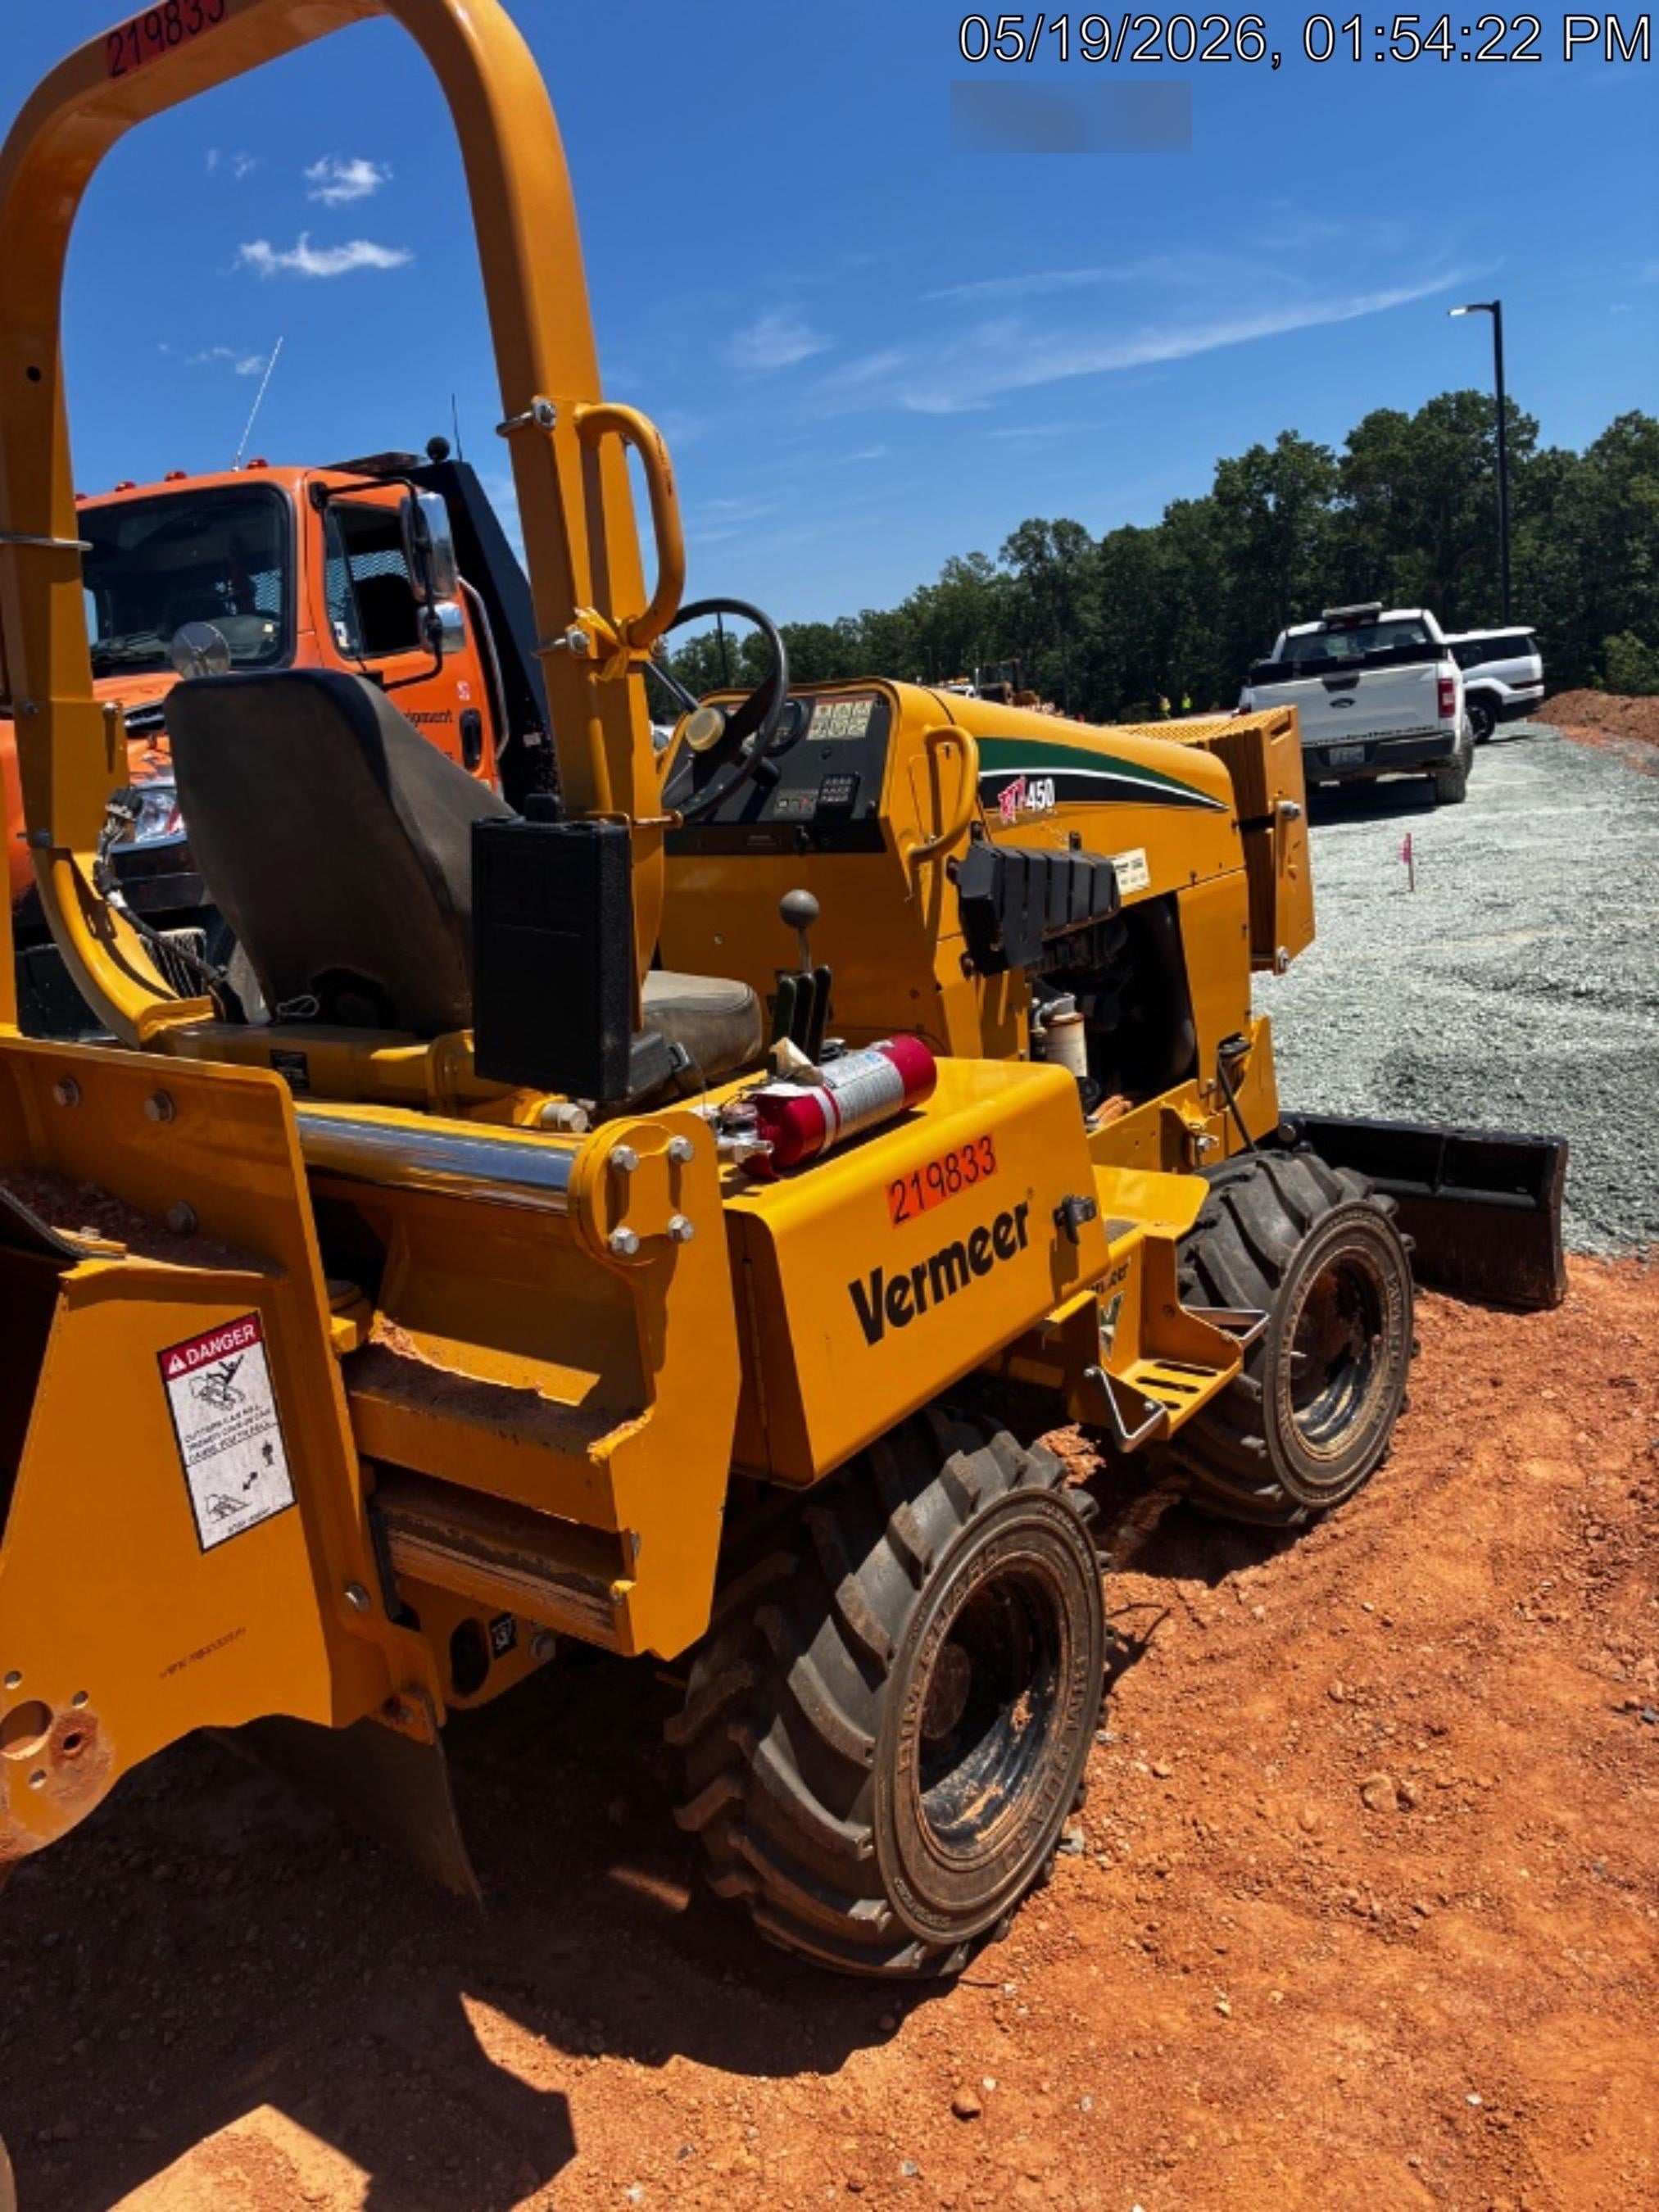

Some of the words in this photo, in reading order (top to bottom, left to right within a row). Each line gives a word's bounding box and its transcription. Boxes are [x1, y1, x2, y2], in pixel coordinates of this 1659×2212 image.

[890, 1135, 996, 1226] 219833
[847, 1201, 1029, 1348] Vermeer
[185, 1323, 256, 1367] DANGER
